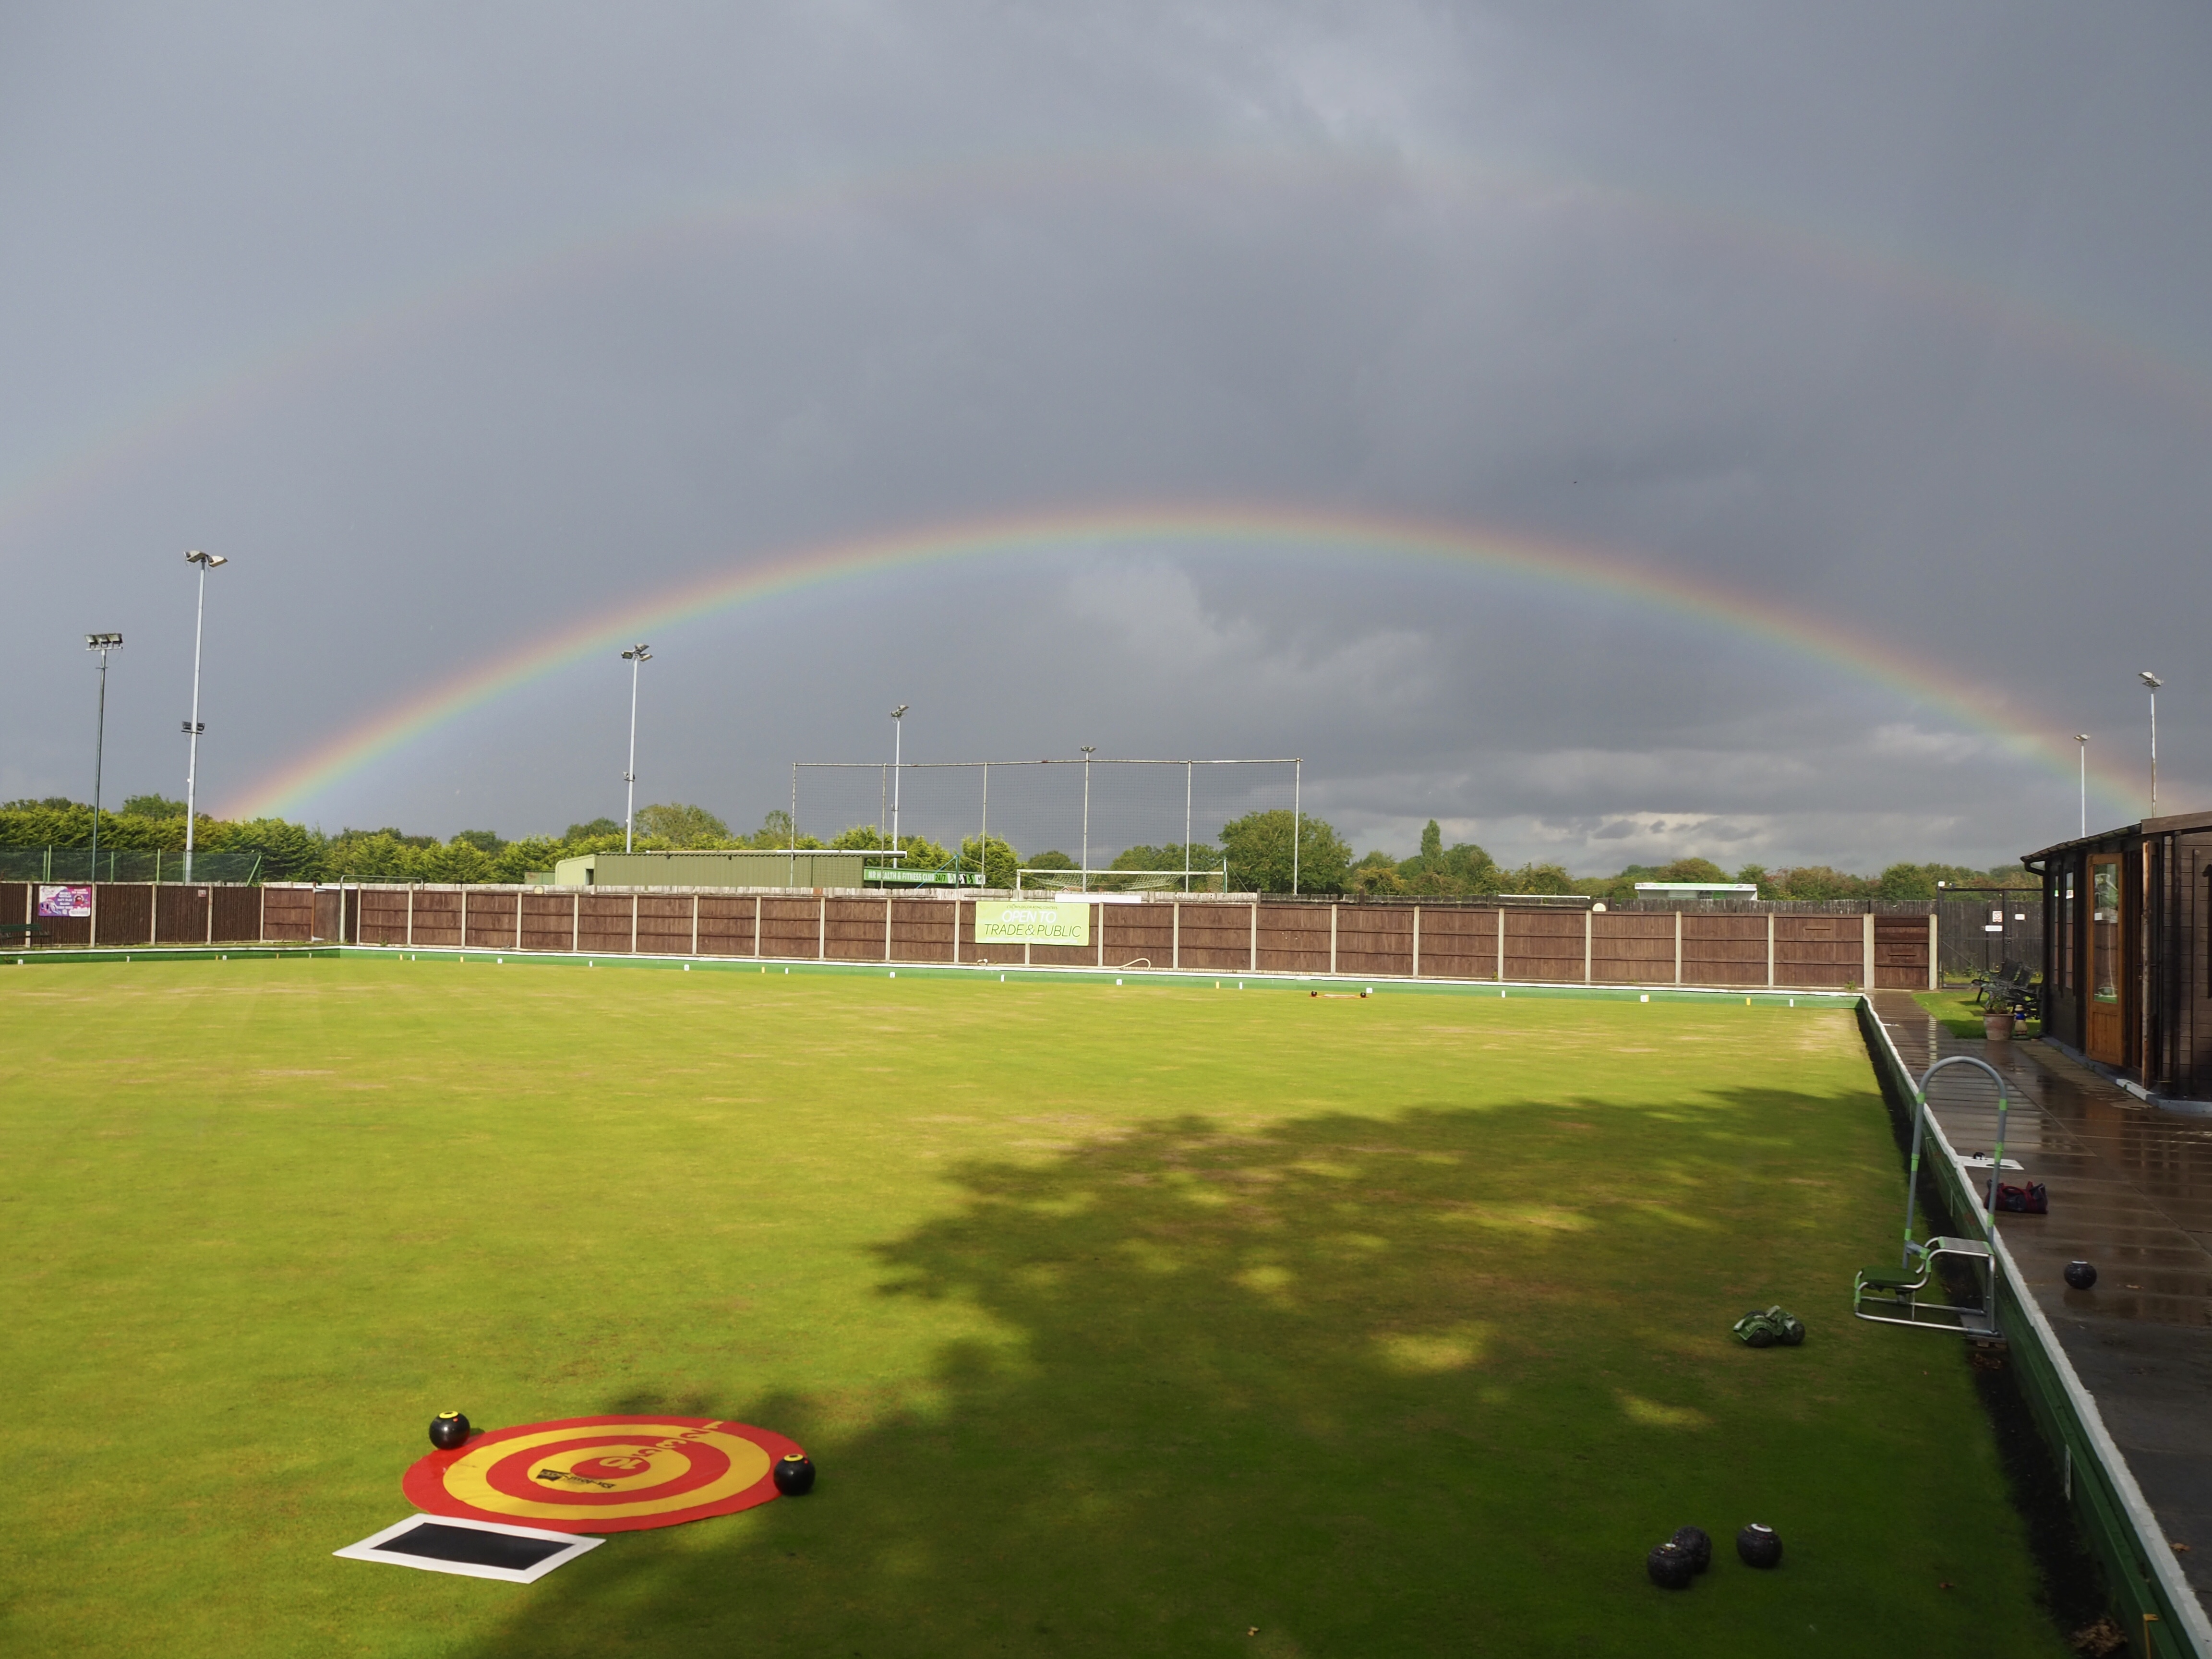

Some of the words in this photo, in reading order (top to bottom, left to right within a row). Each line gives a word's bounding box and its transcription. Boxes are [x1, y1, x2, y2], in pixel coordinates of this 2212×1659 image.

[902, 872, 922, 880] FITNESS
[1002, 911, 1036, 923] OPEN
[1039, 911, 1056, 923] TO
[985, 924, 1024, 935] TRADE
[1025, 924, 1034, 936] &
[1037, 925, 1082, 937] PUBLIC
[702, 1421, 723, 1429] 1
[680, 1429, 710, 1439] 2
[656, 1439, 686, 1450] 3
[632, 1449, 662, 1457] 5
[599, 1457, 642, 1469] 10
